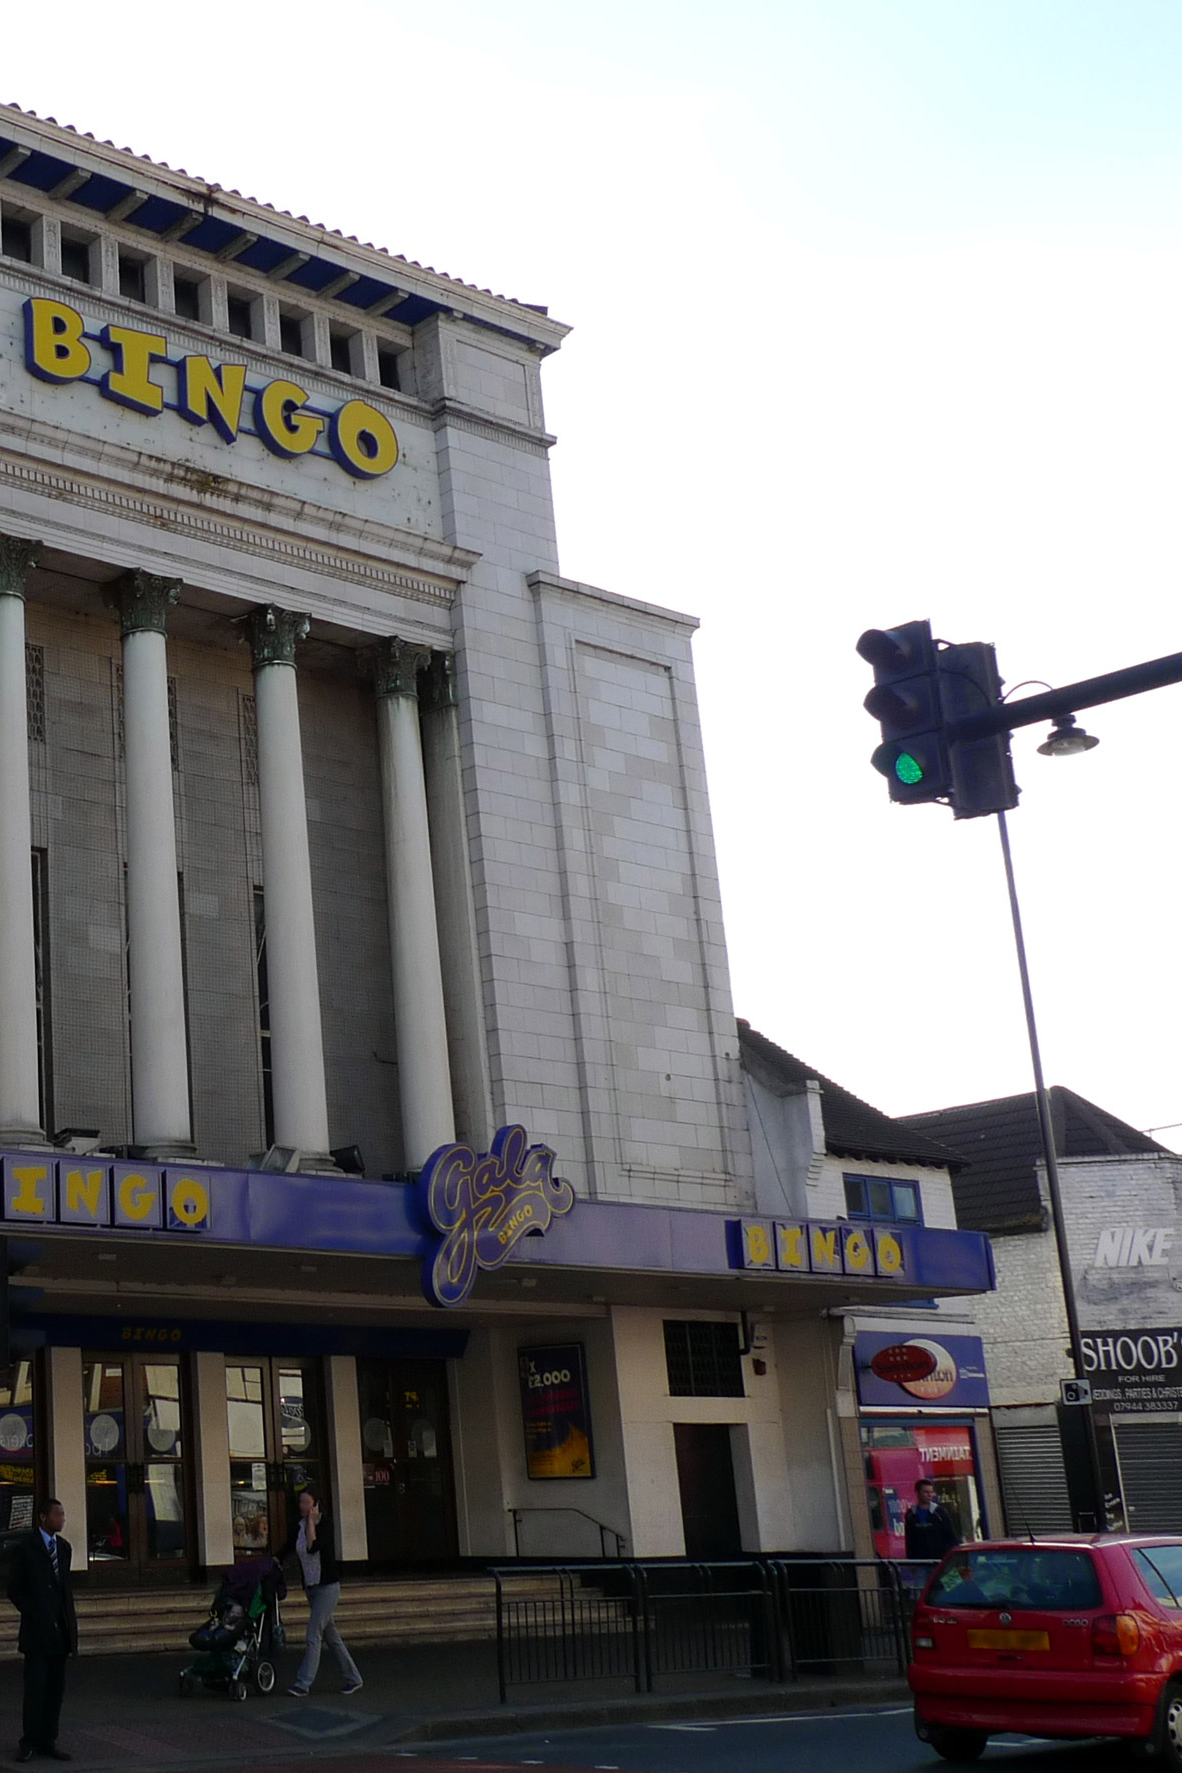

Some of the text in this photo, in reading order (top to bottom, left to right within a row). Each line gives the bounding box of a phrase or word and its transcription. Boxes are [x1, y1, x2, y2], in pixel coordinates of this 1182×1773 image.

[23, 297, 399, 479] BINGO
[429, 1127, 575, 1303] Gala
[498, 1204, 534, 1244] BINGO
[746, 1225, 902, 1272] BINGO
[1094, 1227, 1174, 1267] NIKE
[122, 1326, 183, 1341] BINGO
[1080, 1332, 1182, 1371] SHOOB'
[1118, 1374, 1166, 1383] FOR HIRE
[1114, 1402, 1142, 1411] 07944
